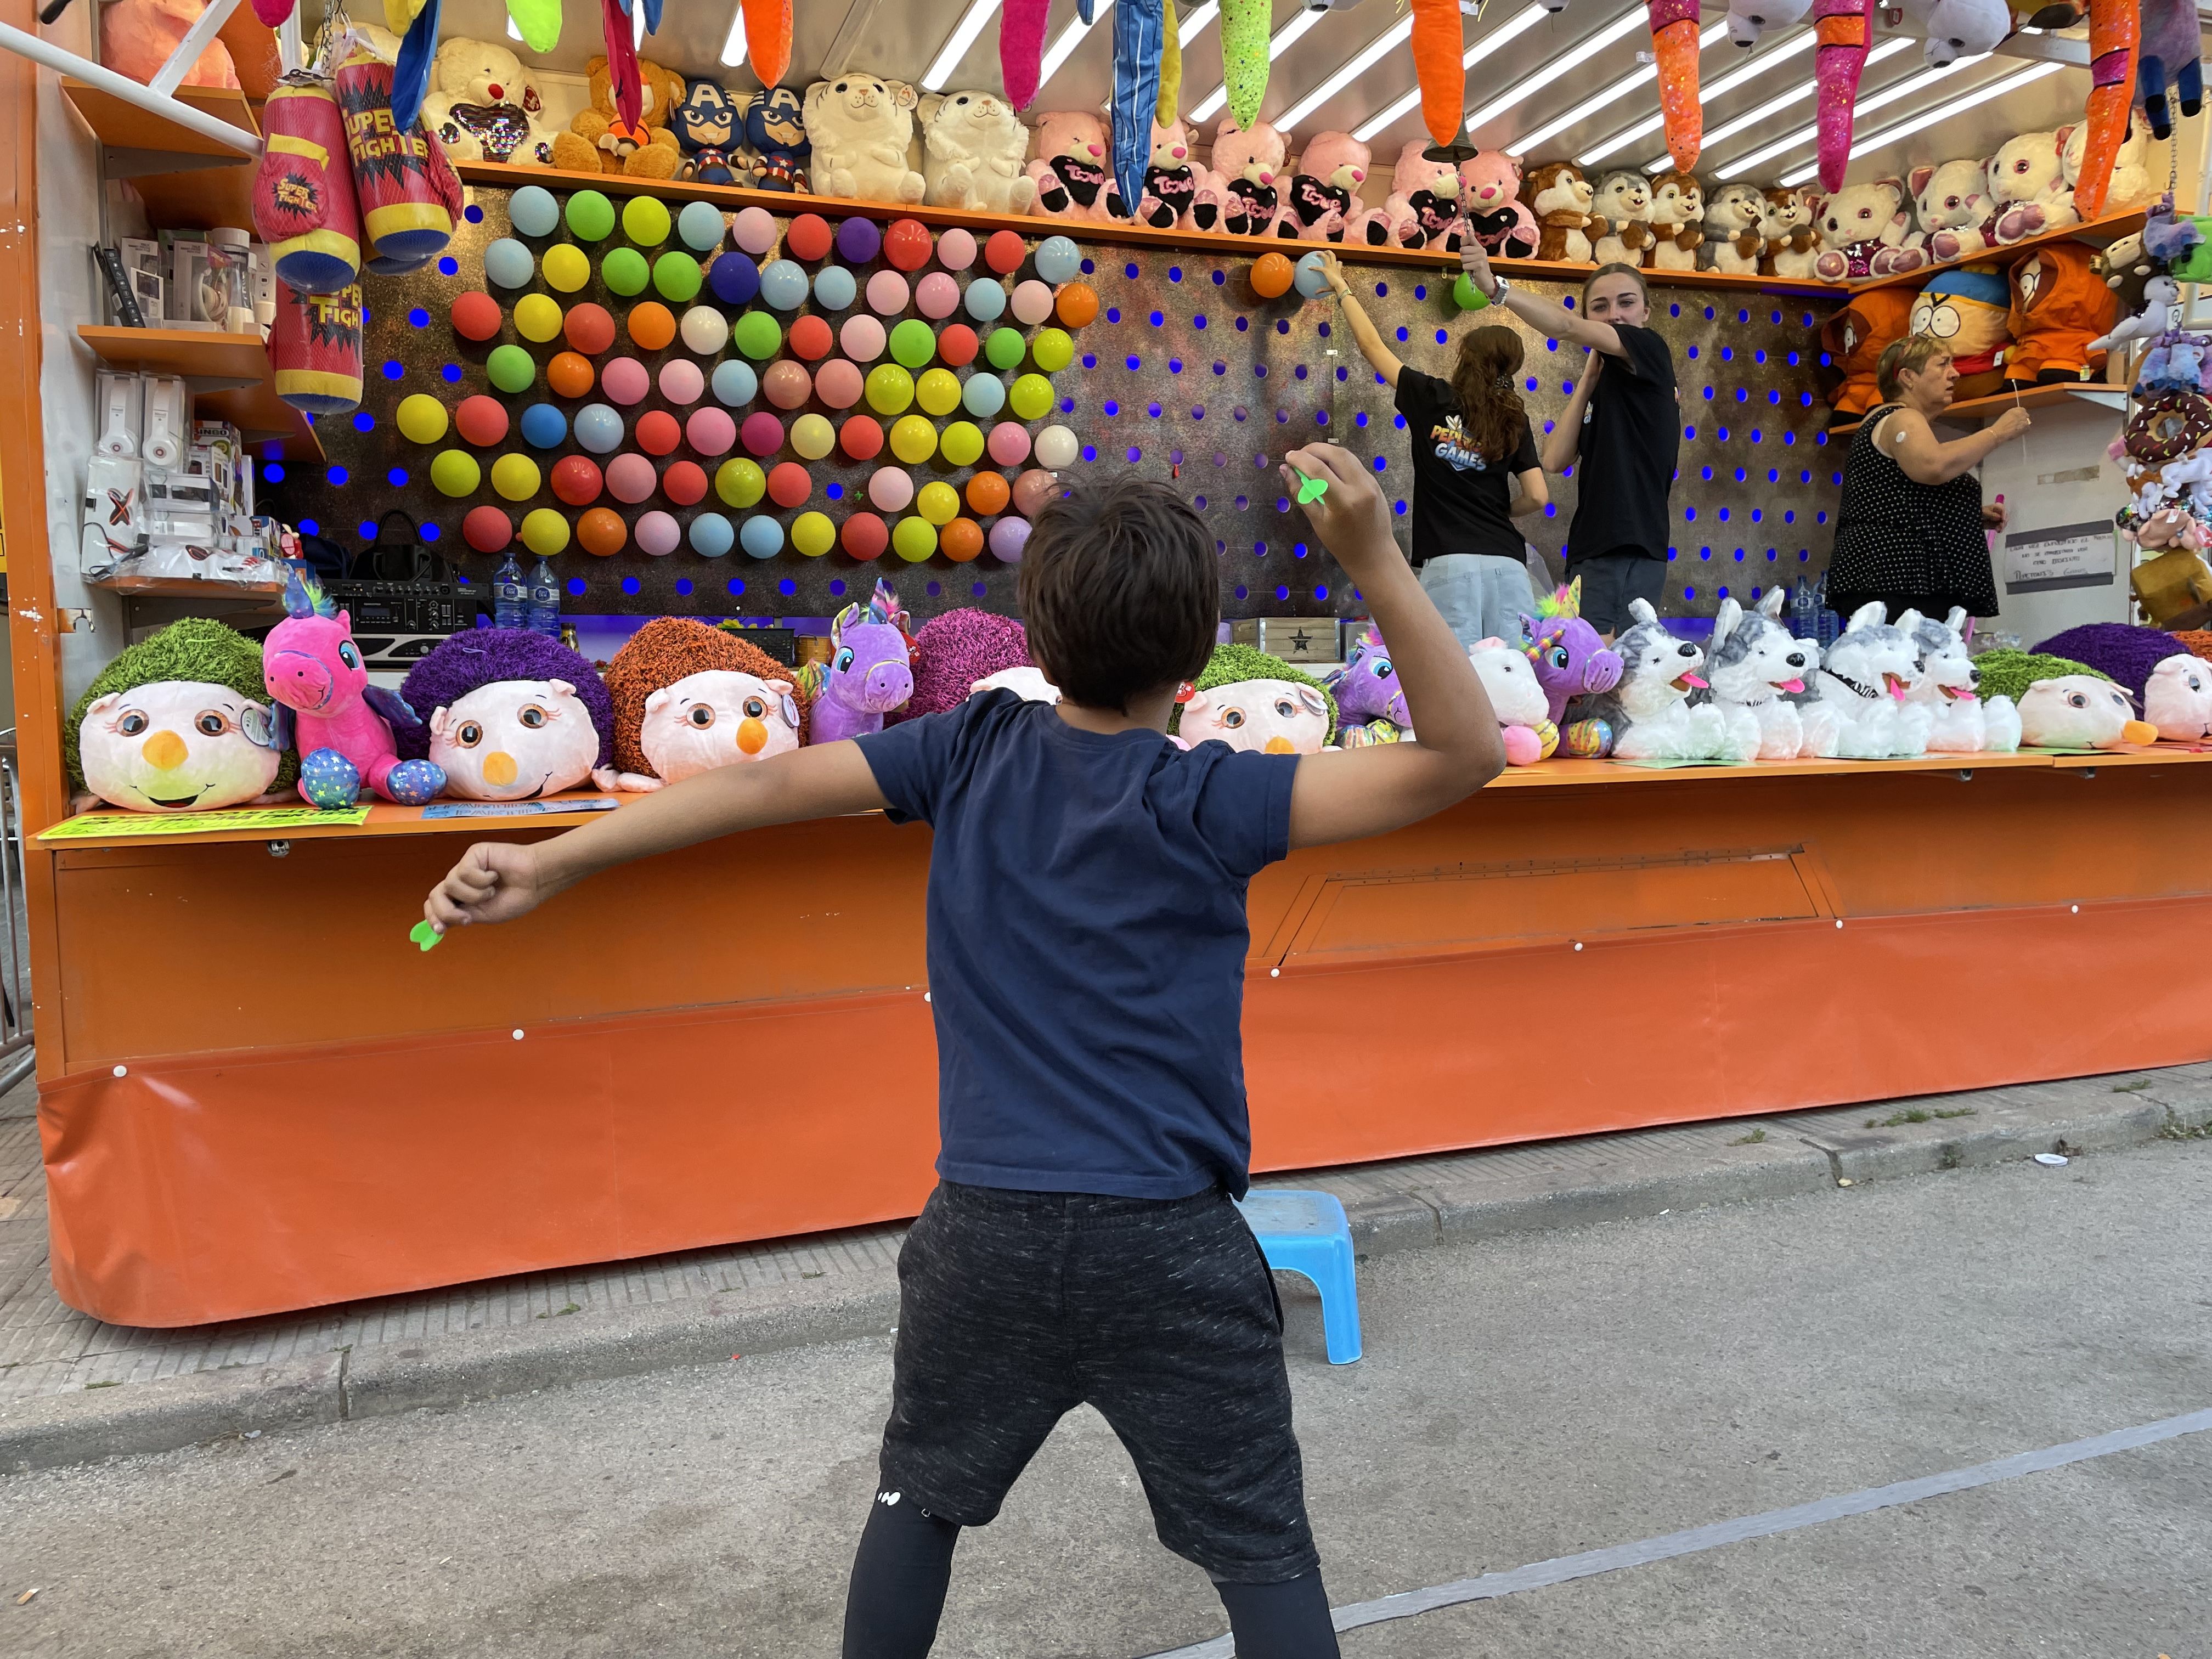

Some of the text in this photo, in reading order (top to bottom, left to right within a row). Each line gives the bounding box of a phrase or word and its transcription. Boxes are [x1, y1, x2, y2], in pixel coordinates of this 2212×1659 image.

[277, 178, 309, 199] SUPER
[278, 190, 317, 213] FIGHTER
[1435, 443, 1486, 471] GAMES
